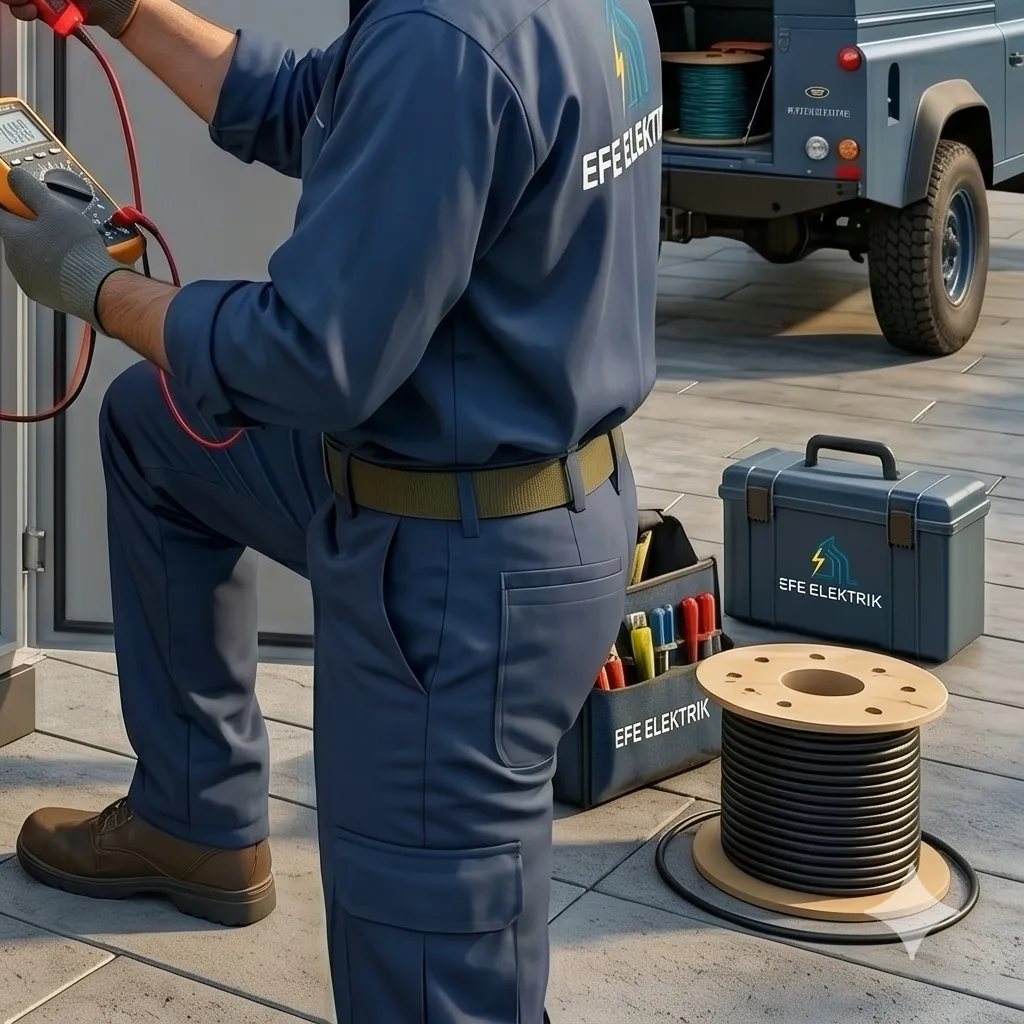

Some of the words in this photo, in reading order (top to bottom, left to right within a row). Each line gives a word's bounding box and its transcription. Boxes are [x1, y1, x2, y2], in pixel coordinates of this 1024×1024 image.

[582, 138, 623, 191] EFE
[779, 577, 806, 594] EFE
[809, 583, 882, 609] ELEKTRIK
[615, 721, 642, 749] EFE
[644, 697, 711, 739] ELEKTRIK
